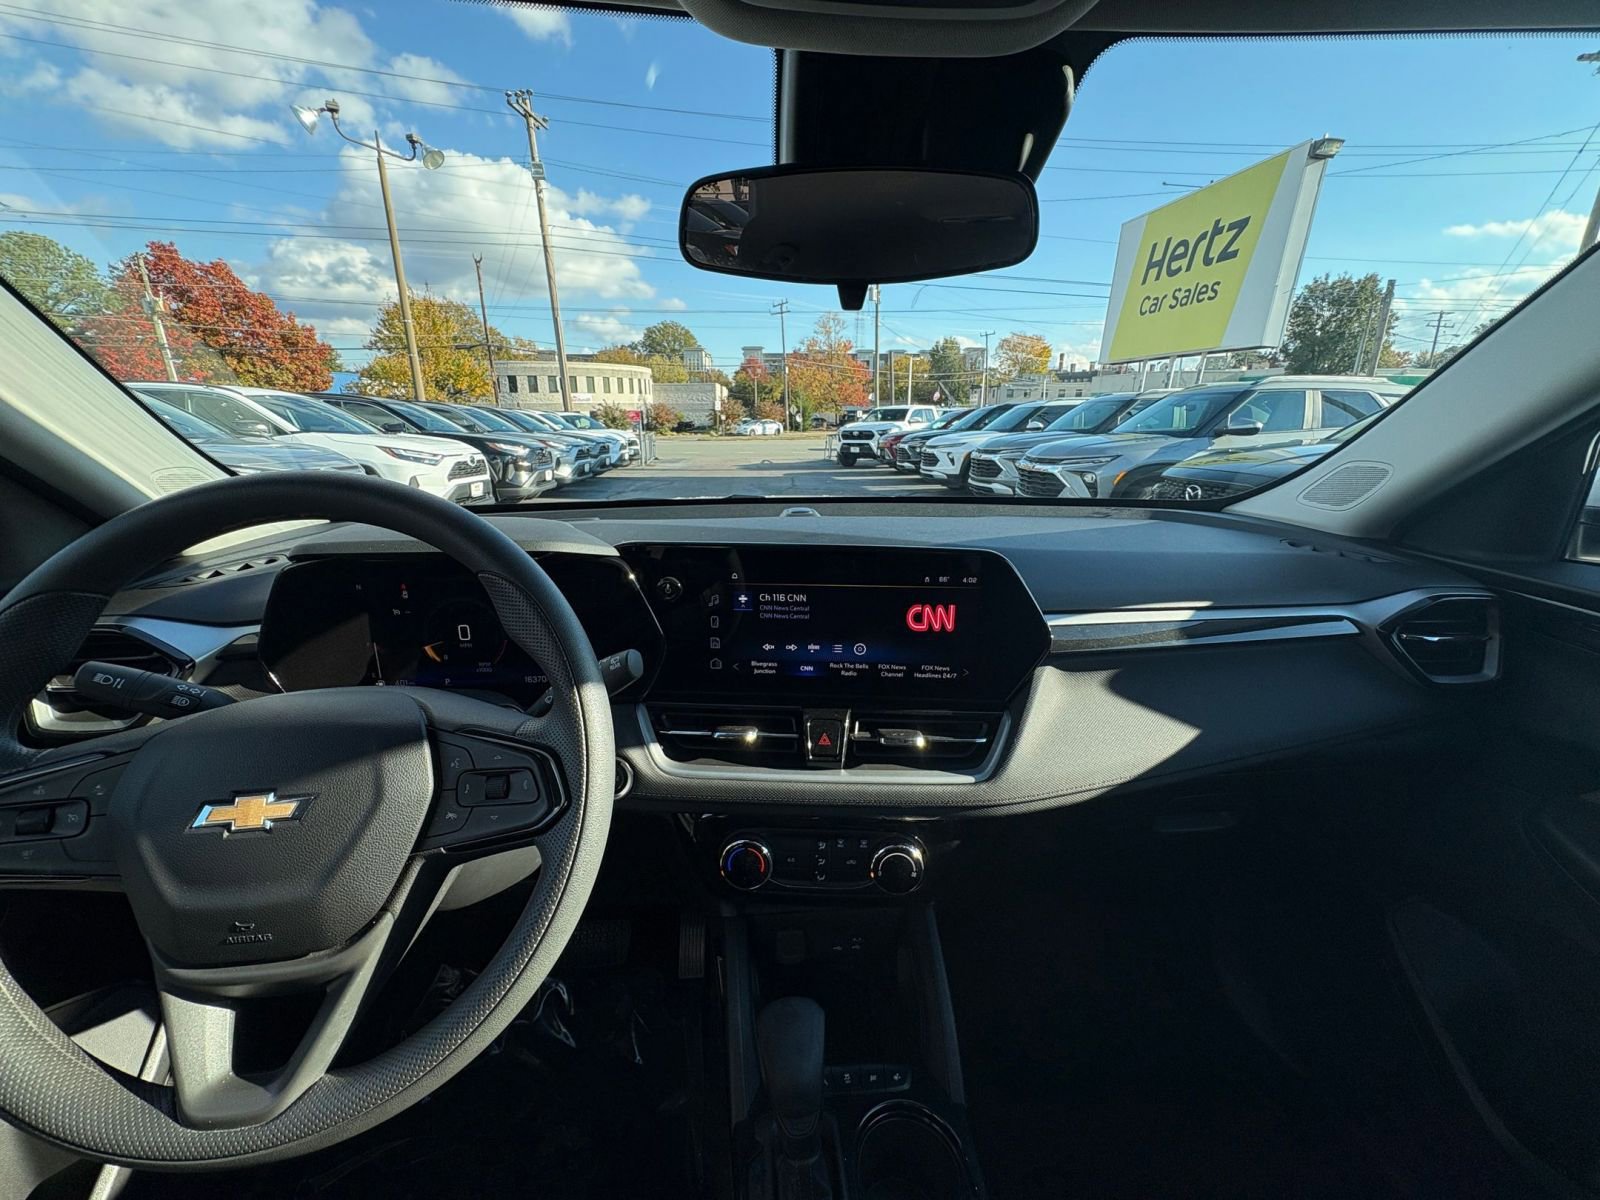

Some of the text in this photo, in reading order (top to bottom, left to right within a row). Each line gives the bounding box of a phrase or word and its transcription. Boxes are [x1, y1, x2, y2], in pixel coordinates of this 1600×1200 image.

[1141, 215, 1252, 286] Hertz
[1139, 279, 1222, 316] Car Sales
[759, 593, 807, 602] Ch 116 CNN
[906, 604, 956, 632] CNN
[458, 624, 471, 641] 0
